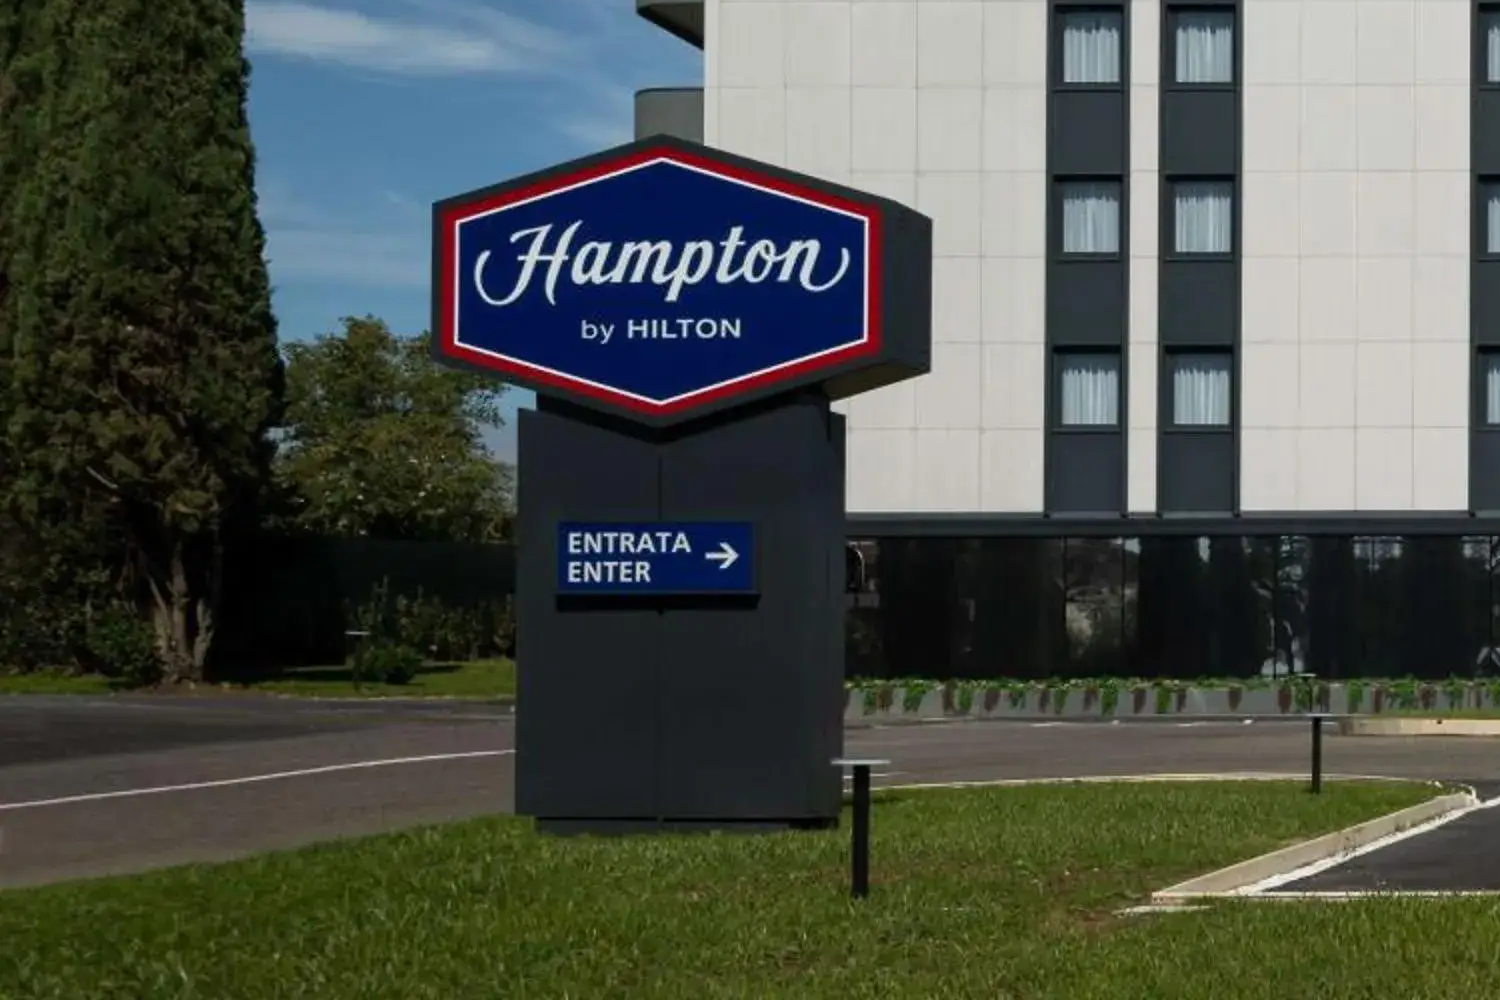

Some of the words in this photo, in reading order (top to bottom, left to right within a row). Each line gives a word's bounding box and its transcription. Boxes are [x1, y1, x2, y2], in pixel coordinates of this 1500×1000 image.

[473, 219, 850, 305] Hampton
[581, 319, 615, 344] by
[627, 318, 742, 339] HILTON
[568, 531, 692, 554] ENTRATA
[568, 561, 651, 583] ENTER
